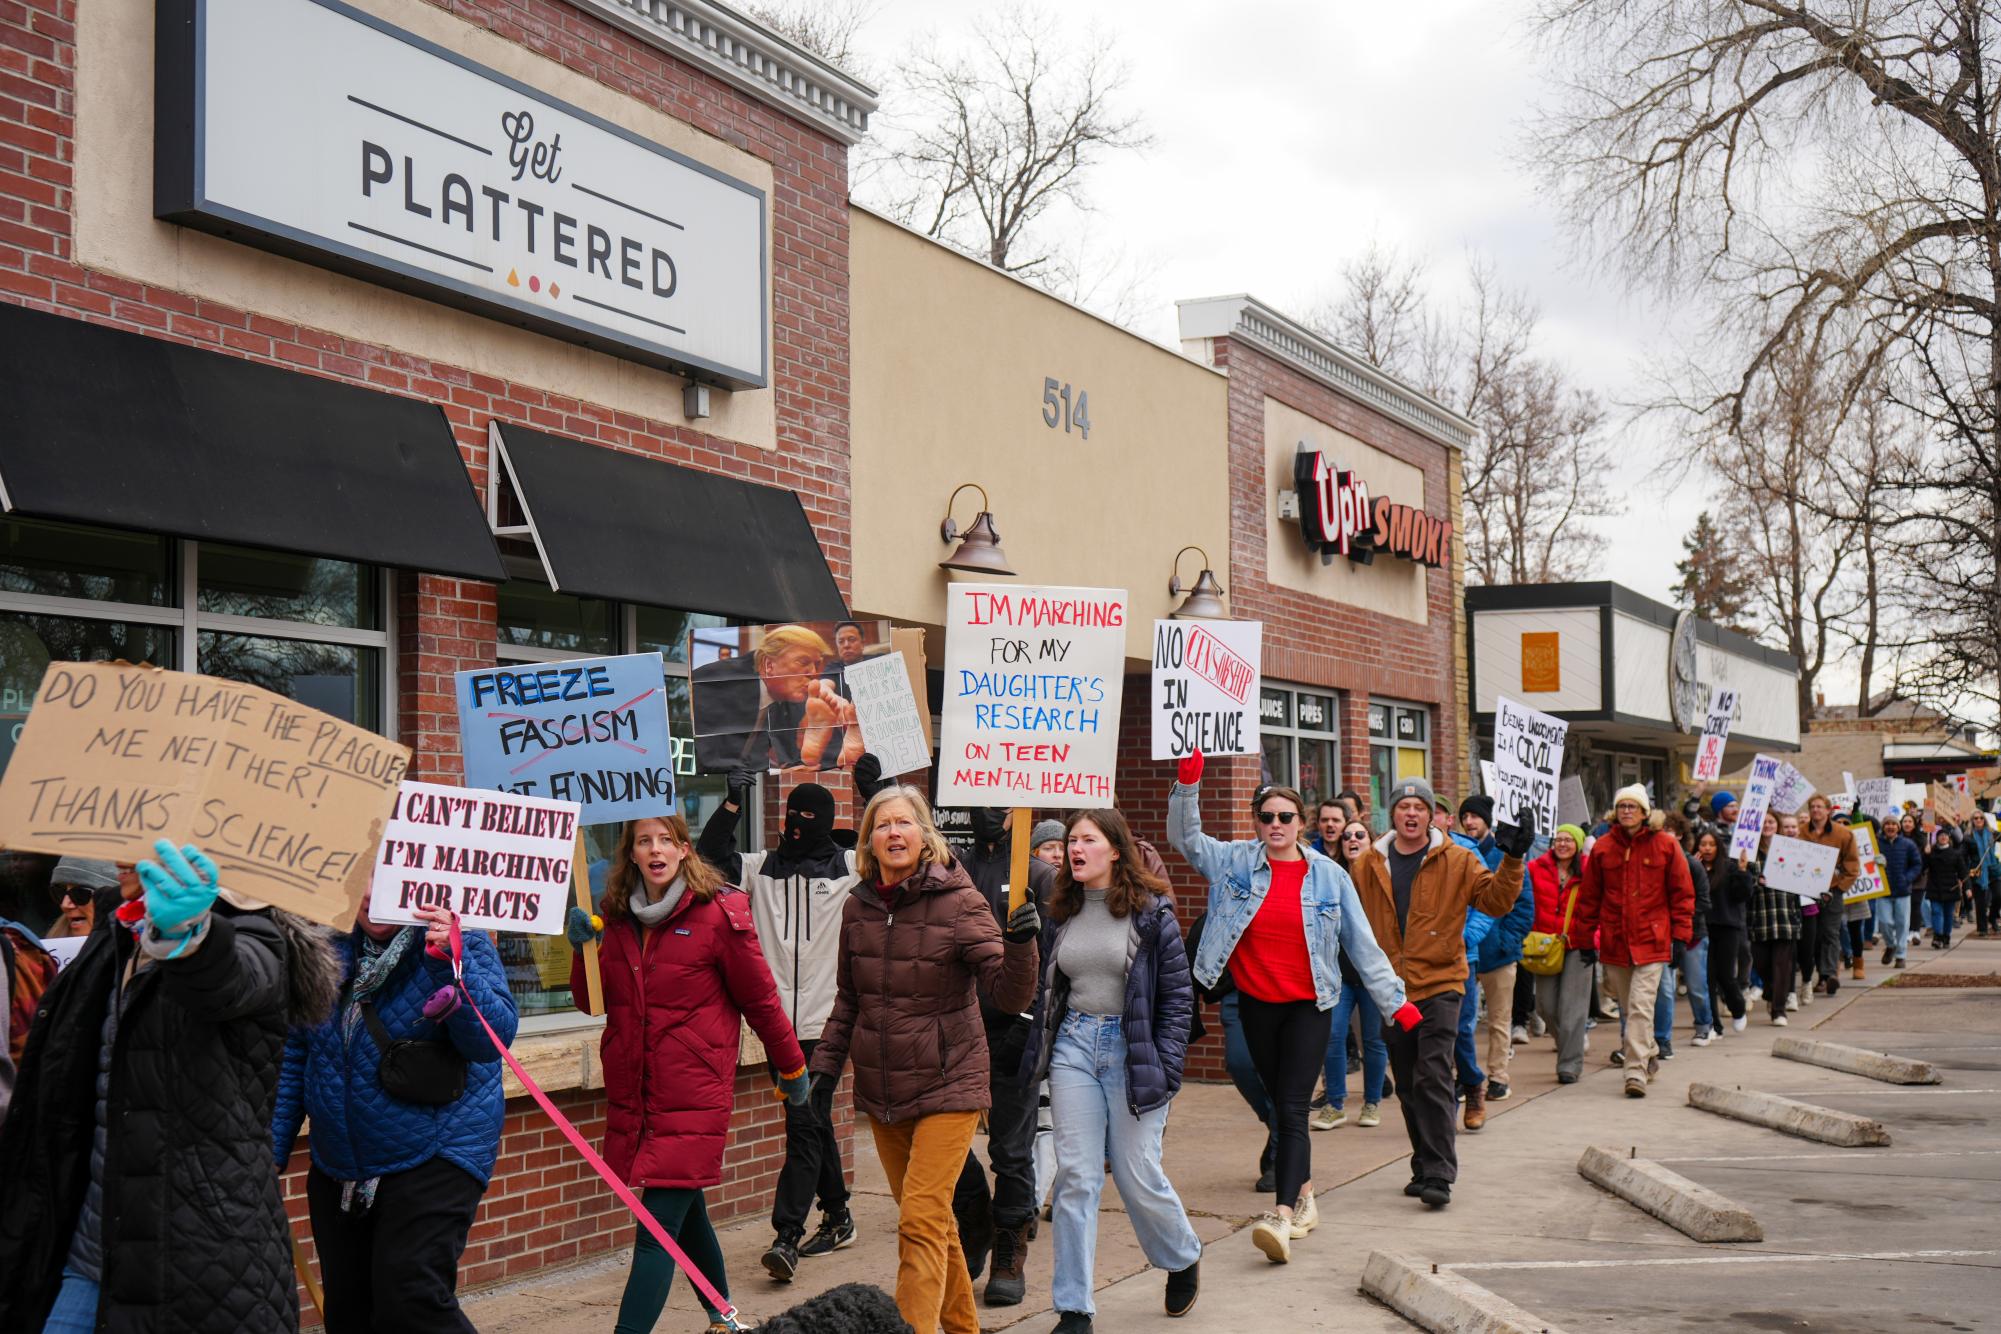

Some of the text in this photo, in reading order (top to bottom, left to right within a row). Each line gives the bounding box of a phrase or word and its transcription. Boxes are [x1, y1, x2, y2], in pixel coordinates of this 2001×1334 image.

[501, 110, 562, 184] Get
[362, 139, 677, 299] PLATTERED
[1042, 376, 1091, 440] 514
[1373, 495, 1453, 568] SMOKE
[965, 591, 1123, 628] I'M MARCHING
[991, 637, 1071, 664] FOR MY
[1156, 624, 1253, 701] NO CENSORSHIP
[470, 666, 615, 709] FREEZE
[958, 670, 1104, 705] DAUGHTER'S
[1163, 679, 1188, 709] IN
[1717, 692, 1733, 711] NO
[44, 671, 408, 786] DO YOU HAVE THE PLAGUE?
[499, 709, 639, 755] FASCISM
[975, 703, 1099, 733] RESEARCH
[1171, 711, 1245, 757] SCIENCE
[1300, 704, 1322, 723] PIPES
[1503, 704, 1524, 733] BEING
[85, 728, 329, 809] ME NEITHER!
[965, 741, 1071, 763] ON TEEN
[1517, 735, 1553, 775] CIVIL
[1754, 759, 1779, 780] THINK
[953, 767, 1111, 798] MENTAL HEALTH
[1498, 788, 1507, 816] A
[1532, 777, 1553, 807] NOT
[29, 777, 358, 883] THANKS SCIENCE!
[390, 791, 575, 841] I CAN'T BELIEVE
[382, 840, 569, 884] I'M MARCHING
[398, 880, 541, 922] FOR FACTS
